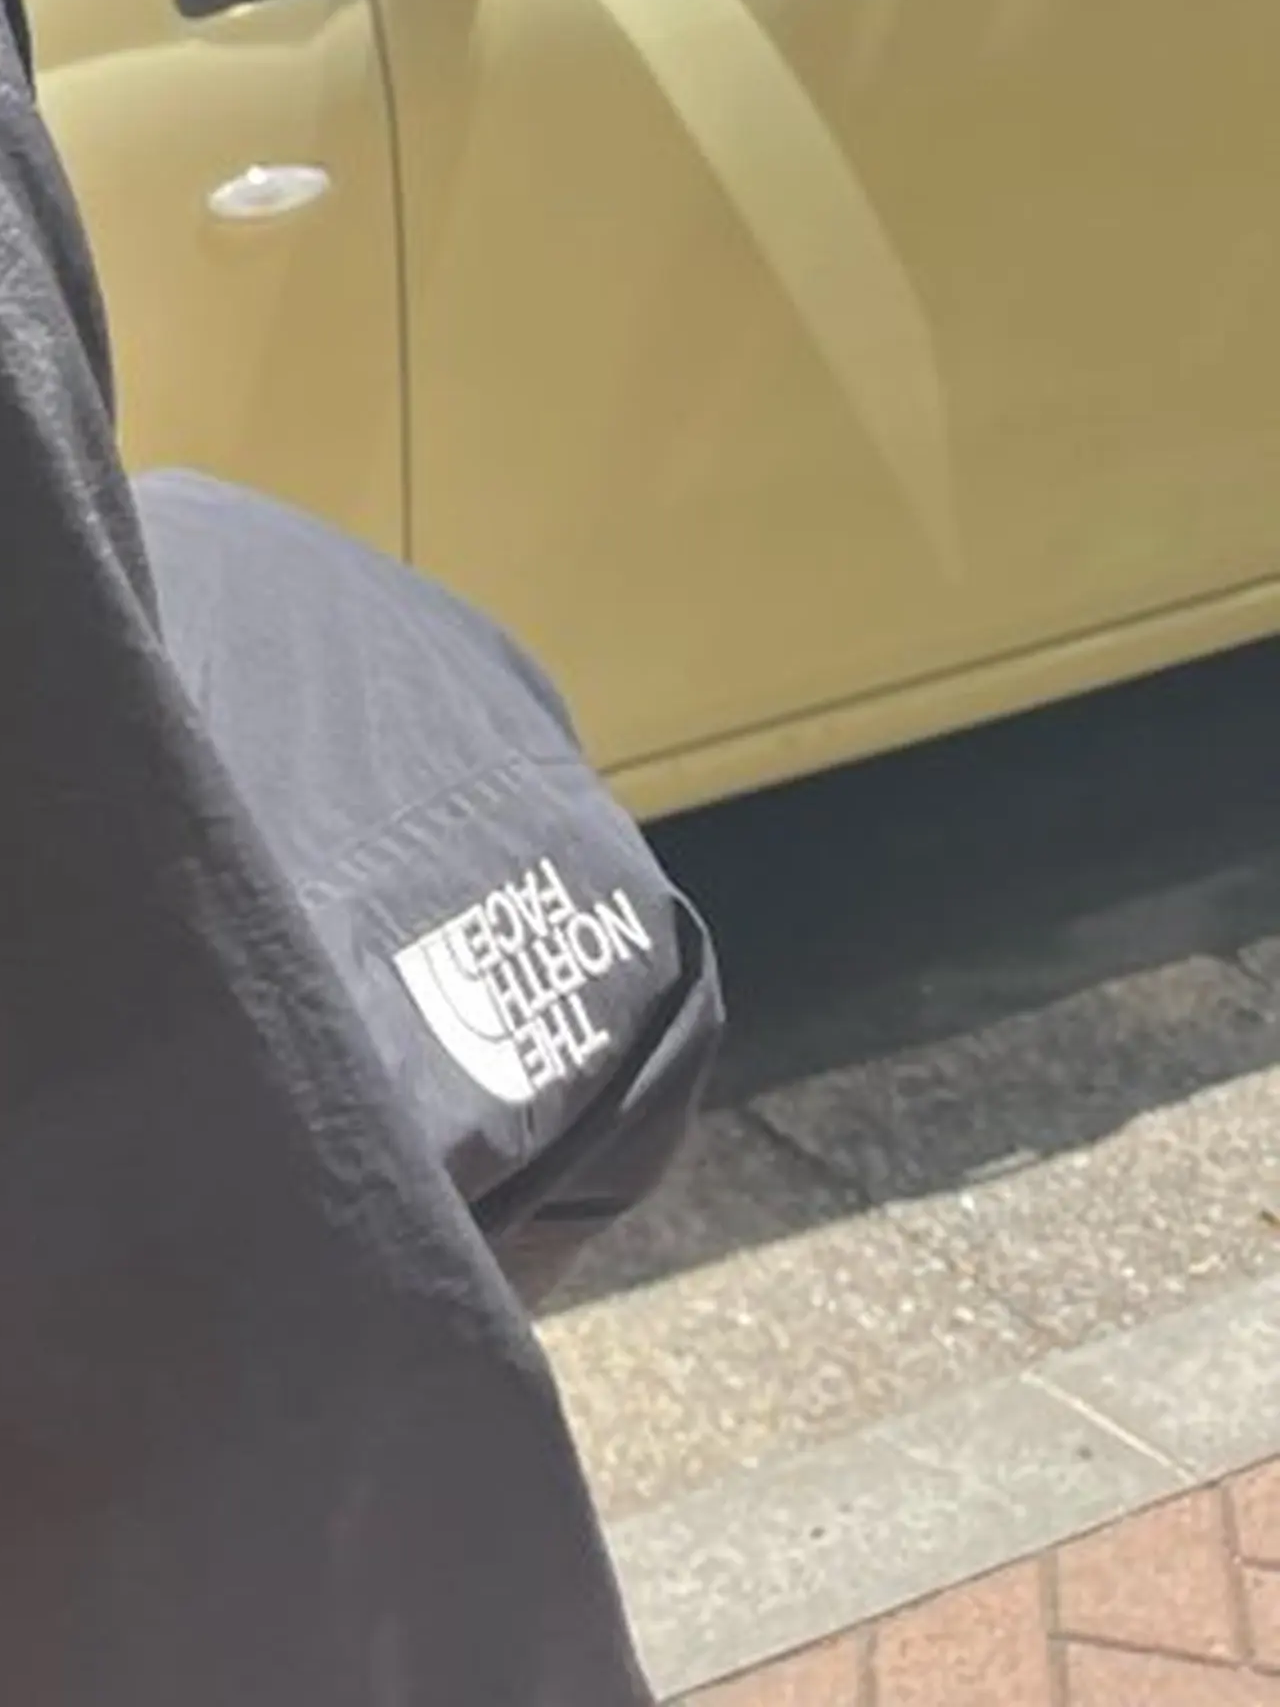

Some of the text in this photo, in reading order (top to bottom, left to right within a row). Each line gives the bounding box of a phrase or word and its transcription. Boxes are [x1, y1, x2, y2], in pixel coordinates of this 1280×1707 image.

[461, 856, 578, 971] FACE
[488, 887, 652, 1032] NORTH
[514, 990, 611, 1090] THE
